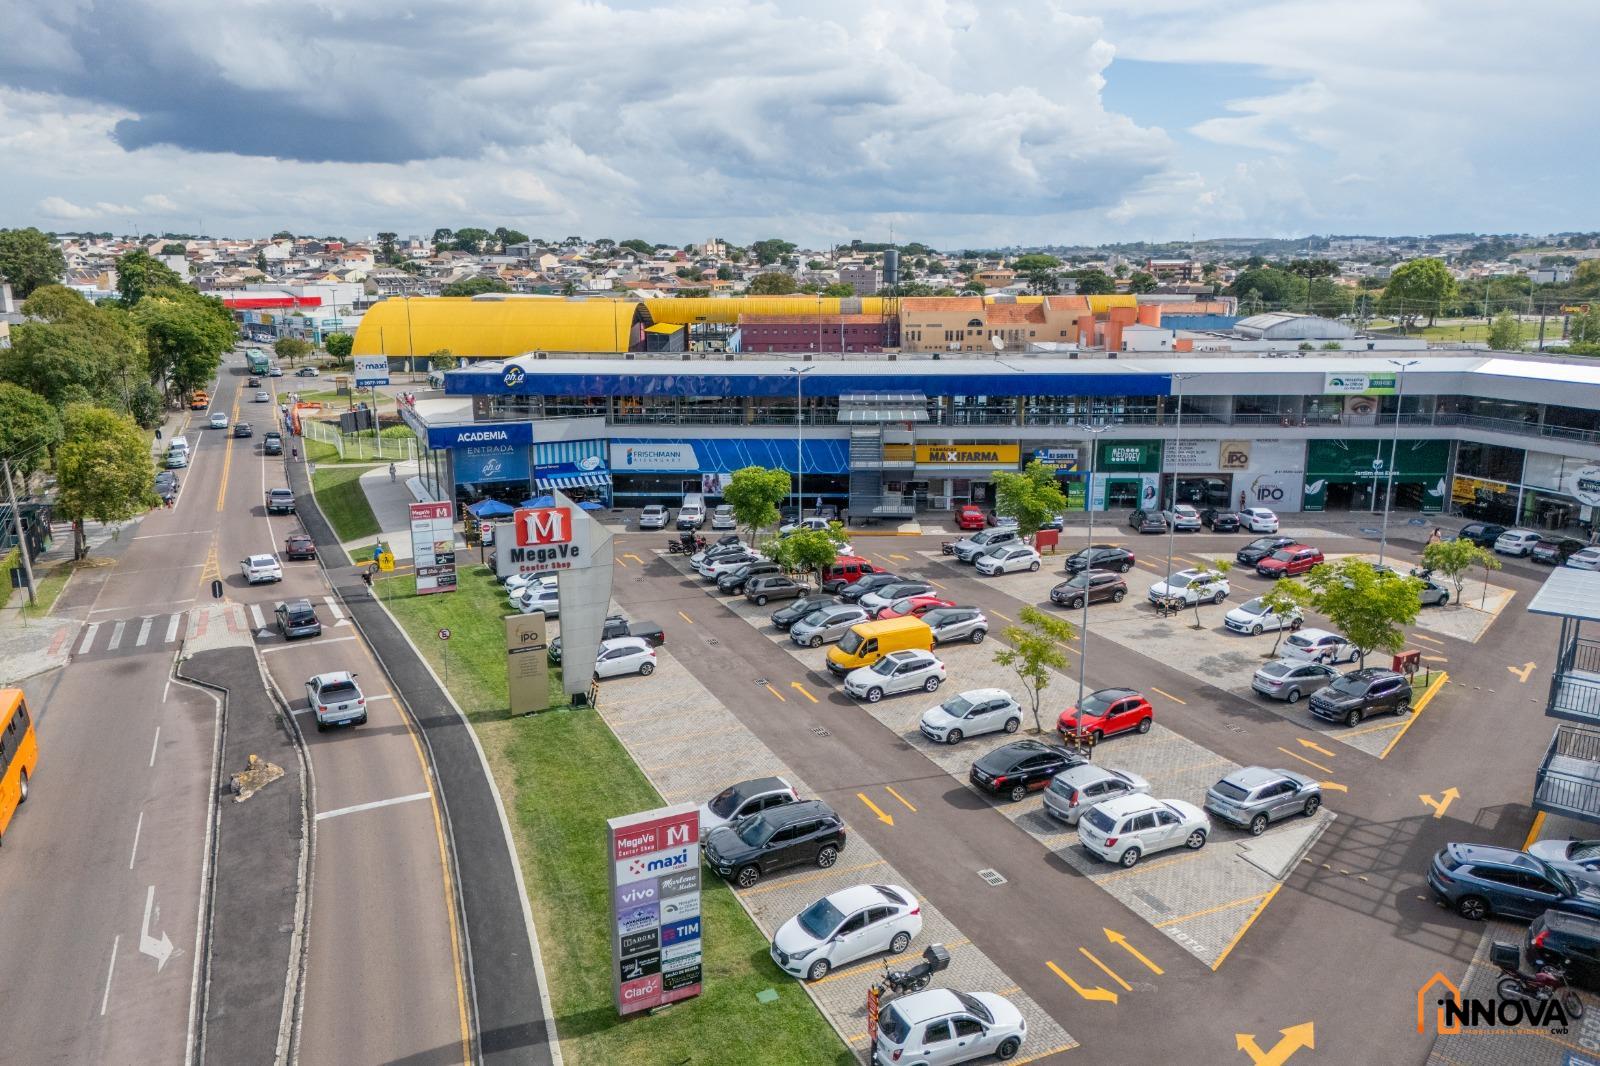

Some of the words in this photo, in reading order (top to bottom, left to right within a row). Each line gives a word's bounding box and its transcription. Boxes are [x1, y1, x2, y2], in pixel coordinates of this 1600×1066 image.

[365, 361, 387, 370] maxi
[457, 430, 508, 442] ACADEMIA
[467, 445, 514, 455] ENTRADA
[930, 452, 999, 461] MAXIFARMA
[1228, 454, 1248, 464] IPO
[1258, 488, 1284, 500] IPO
[525, 511, 565, 544] M
[510, 544, 580, 563] MegaVe
[520, 563, 549, 572] Center
[521, 633, 538, 642] IPO
[618, 833, 655, 849] MegaVe
[666, 823, 690, 846] M
[647, 848, 687, 872] maxi
[622, 888, 655, 903] vivo
[677, 922, 699, 937] TIM
[624, 985, 653, 999] Claro
